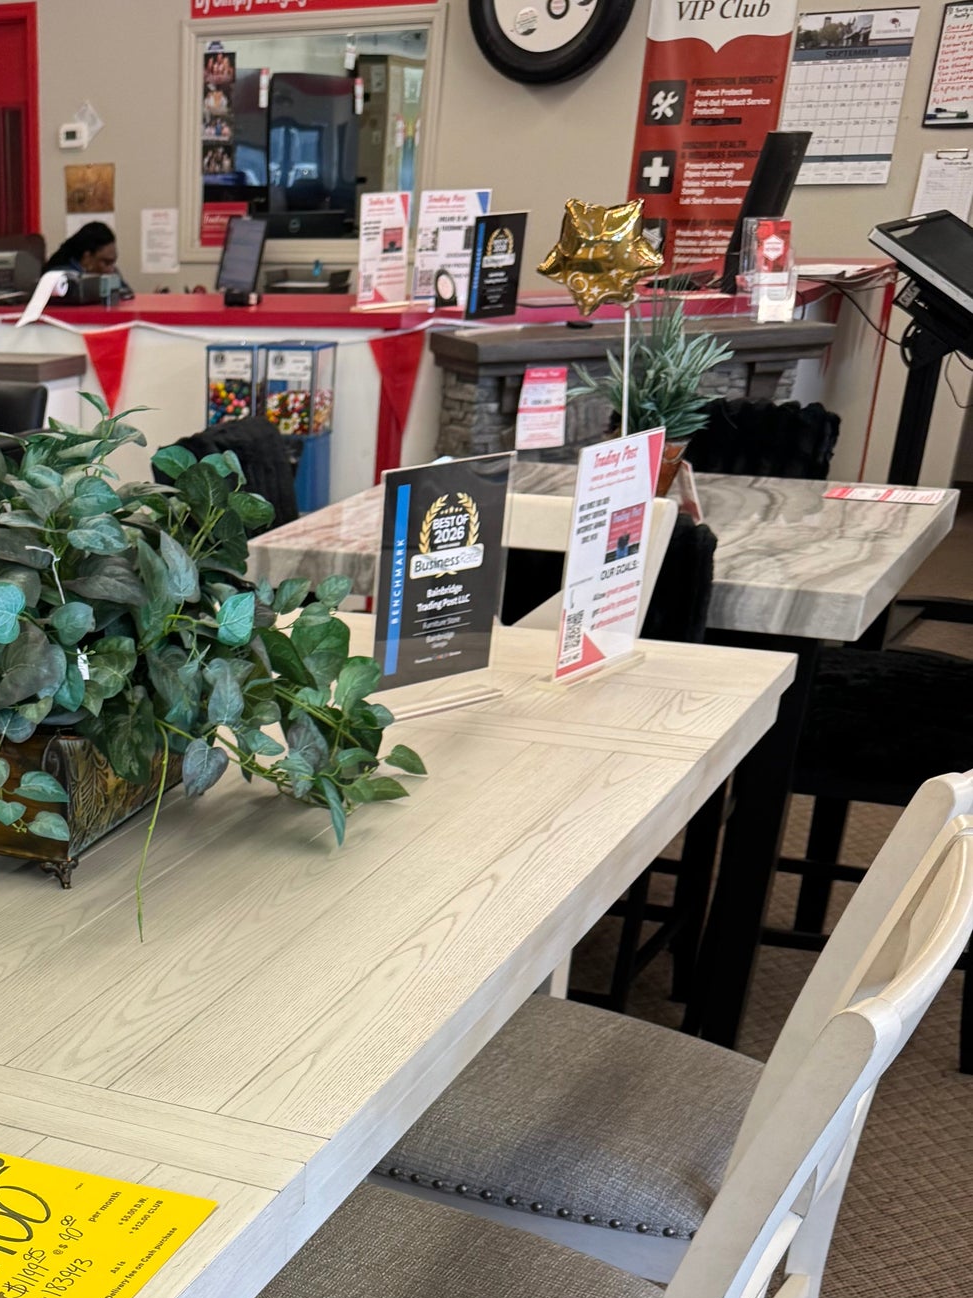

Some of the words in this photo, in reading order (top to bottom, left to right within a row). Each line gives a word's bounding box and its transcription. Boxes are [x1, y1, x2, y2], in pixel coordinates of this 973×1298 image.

[677, 0, 715, 20] VIP
[720, 0, 771, 19] Club
[825, 49, 878, 58] SEPTEMBER
[695, 89, 719, 97] Product
[720, 88, 753, 96] Protection
[432, 515, 456, 530] BEST
[455, 513, 470, 526] OF
[433, 526, 465, 544] 2026
[390, 539, 405, 625] BENCHMARK
[426, 583, 464, 598] Bainbridge
[416, 600, 443, 613] Trading
[442, 597, 458, 607] Post
[457, 593, 471, 604] LLC
[87, 1210, 101, 1223] per
[99, 1191, 122, 1212] month
[147, 1199, 164, 1216] CLUB
[124, 1269, 137, 1283] fee
[134, 1262, 145, 1273] on
[140, 1248, 157, 1264] Cash
[153, 1226, 178, 1251] purchase
[41, 1257, 94, 1297] 183943
[110, 1265, 120, 1275] As
